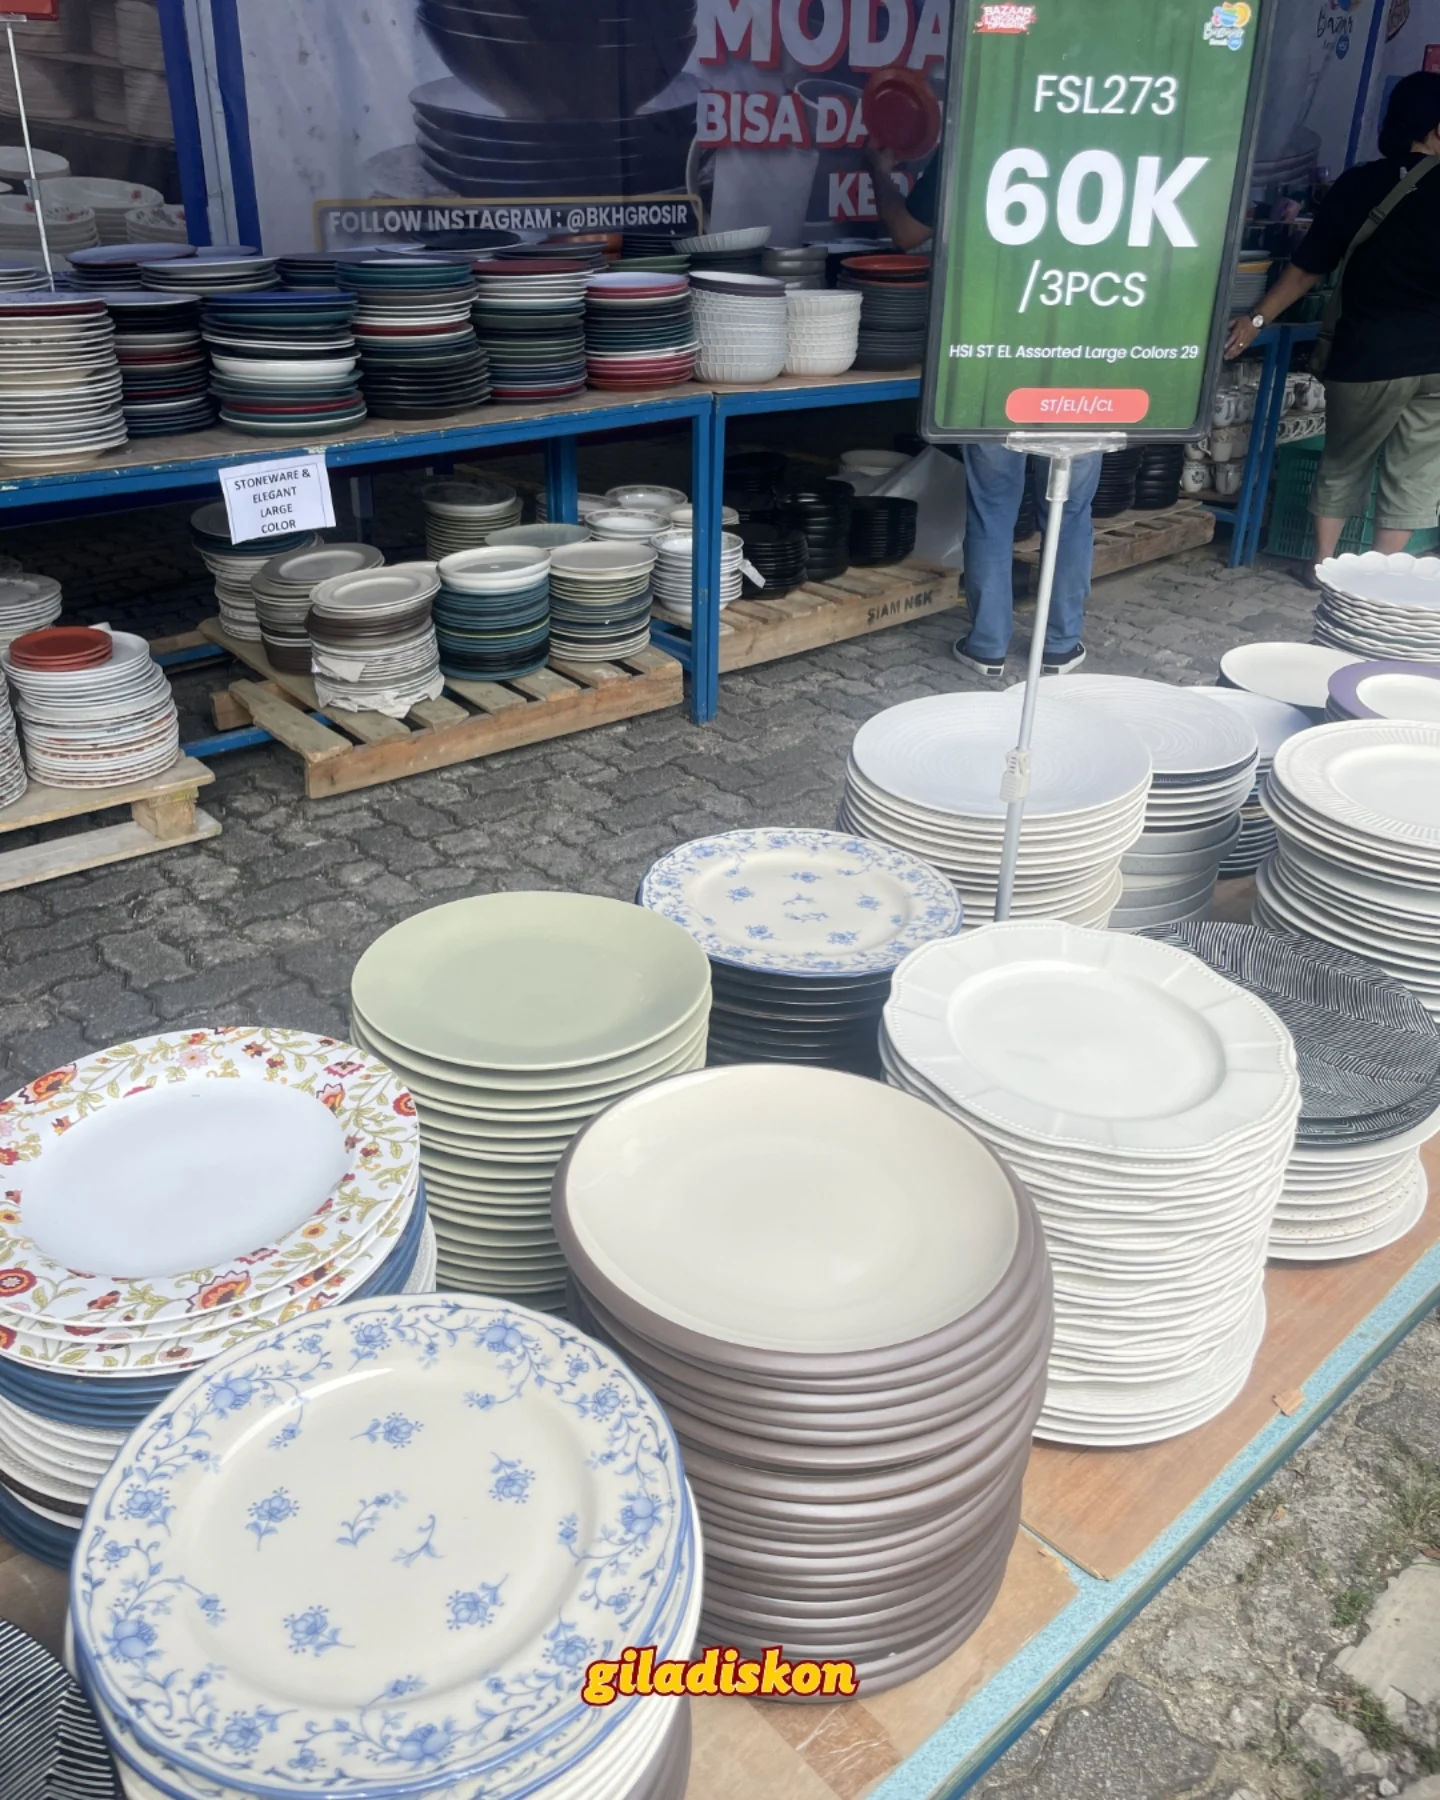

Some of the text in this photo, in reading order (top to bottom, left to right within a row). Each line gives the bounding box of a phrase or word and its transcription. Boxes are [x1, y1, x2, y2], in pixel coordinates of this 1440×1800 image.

[983, 5, 1033, 16] BAZAAR
[1034, 75, 1178, 115] FSL273
[697, 91, 811, 148] BISA
[986, 148, 1211, 248] 60K
[329, 209, 422, 233] FOLLOW
[428, 208, 552, 231] INSTAGRAM
[567, 204, 688, 233] @BKHGROSIR
[1018, 259, 1147, 314] /3PCS
[949, 344, 1199, 363] HSI ST EL Assorted Large Colors 29
[1040, 396, 1114, 414] ST/EL/L/CL
[234, 468, 311, 491] STONEWARE &
[252, 486, 297, 504] ELEGANT
[260, 503, 293, 518] LARGE
[261, 519, 297, 534] COLOR
